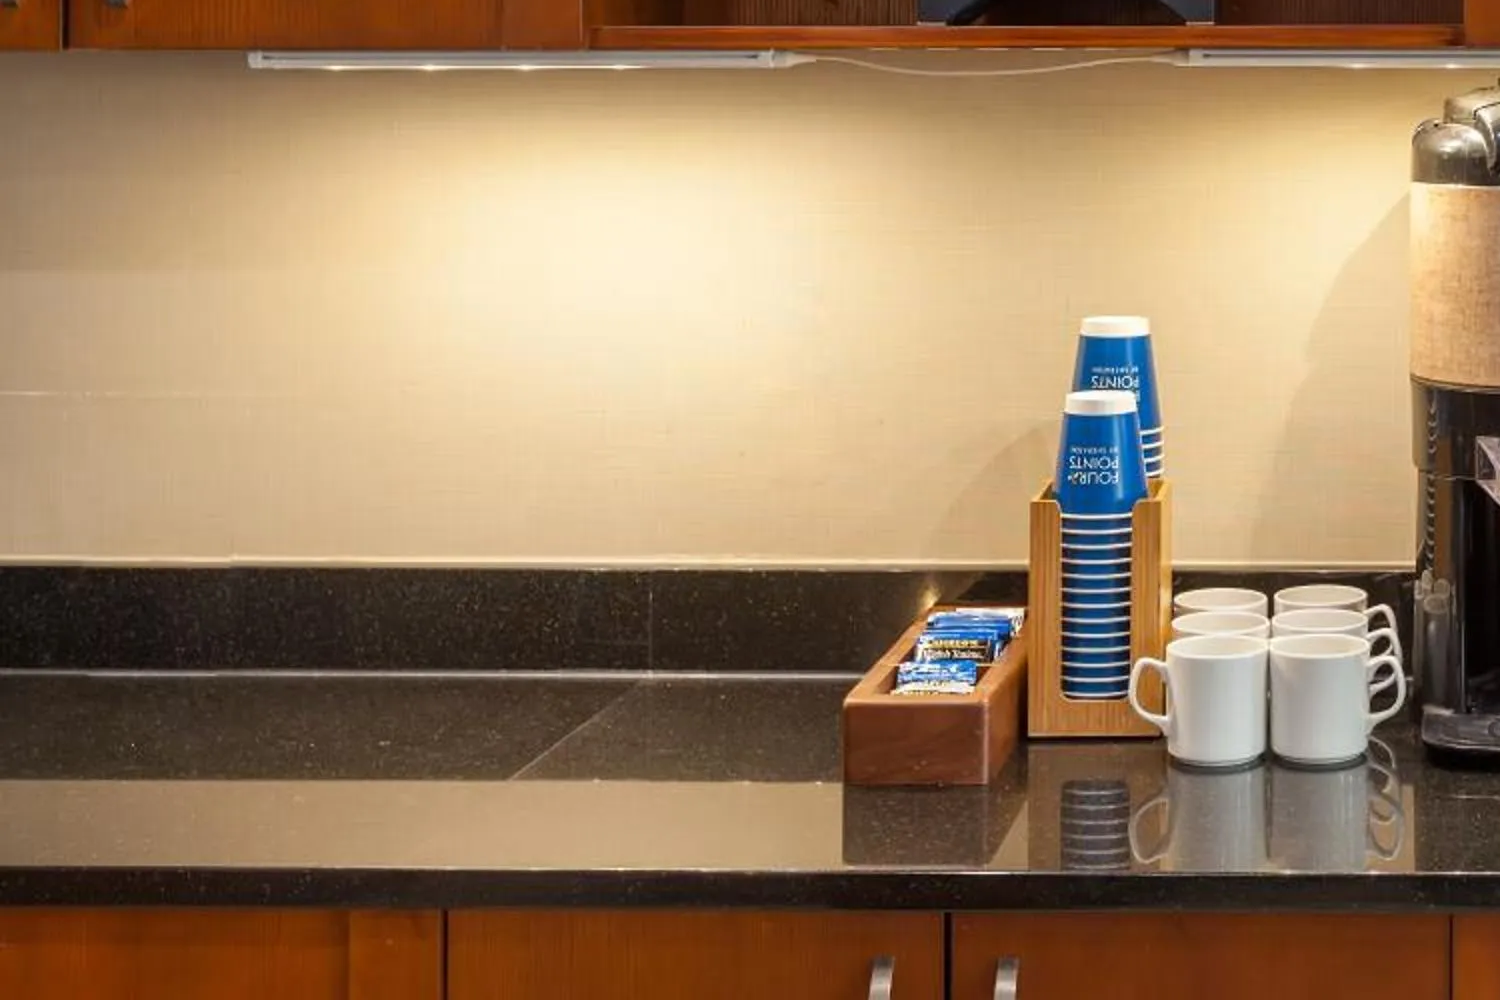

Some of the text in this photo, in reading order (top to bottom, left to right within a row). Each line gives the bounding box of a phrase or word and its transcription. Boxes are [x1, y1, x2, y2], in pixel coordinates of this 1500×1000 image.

[1091, 375, 1139, 389] POINTS
[1069, 456, 1119, 469] POINTS
[1079, 471, 1119, 485] FOUR
